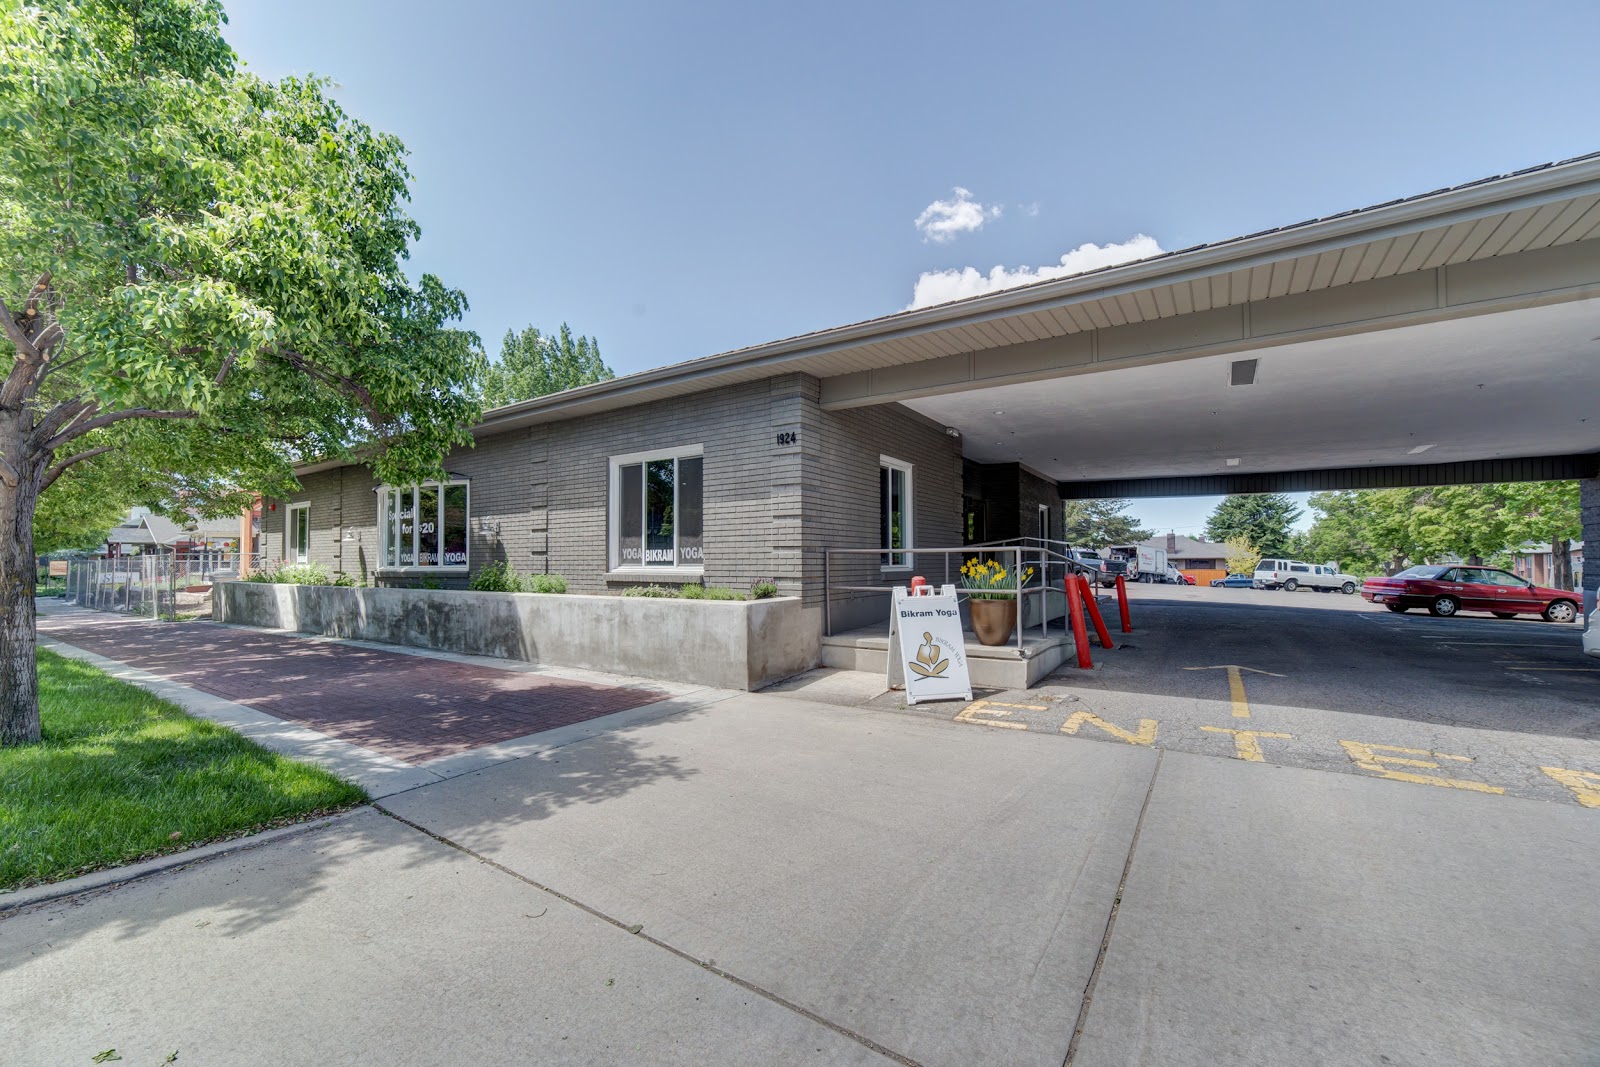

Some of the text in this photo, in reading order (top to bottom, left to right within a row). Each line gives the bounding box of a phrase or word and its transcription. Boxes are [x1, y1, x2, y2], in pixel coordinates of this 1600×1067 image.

[777, 431, 796, 446] 1924
[402, 523, 413, 535] for
[400, 553, 414, 563] YOGA
[445, 552, 467, 562] YOGA
[622, 546, 704, 562] YOGA BIKRAM YOGA
[900, 609, 958, 618] Bikram Yoga
